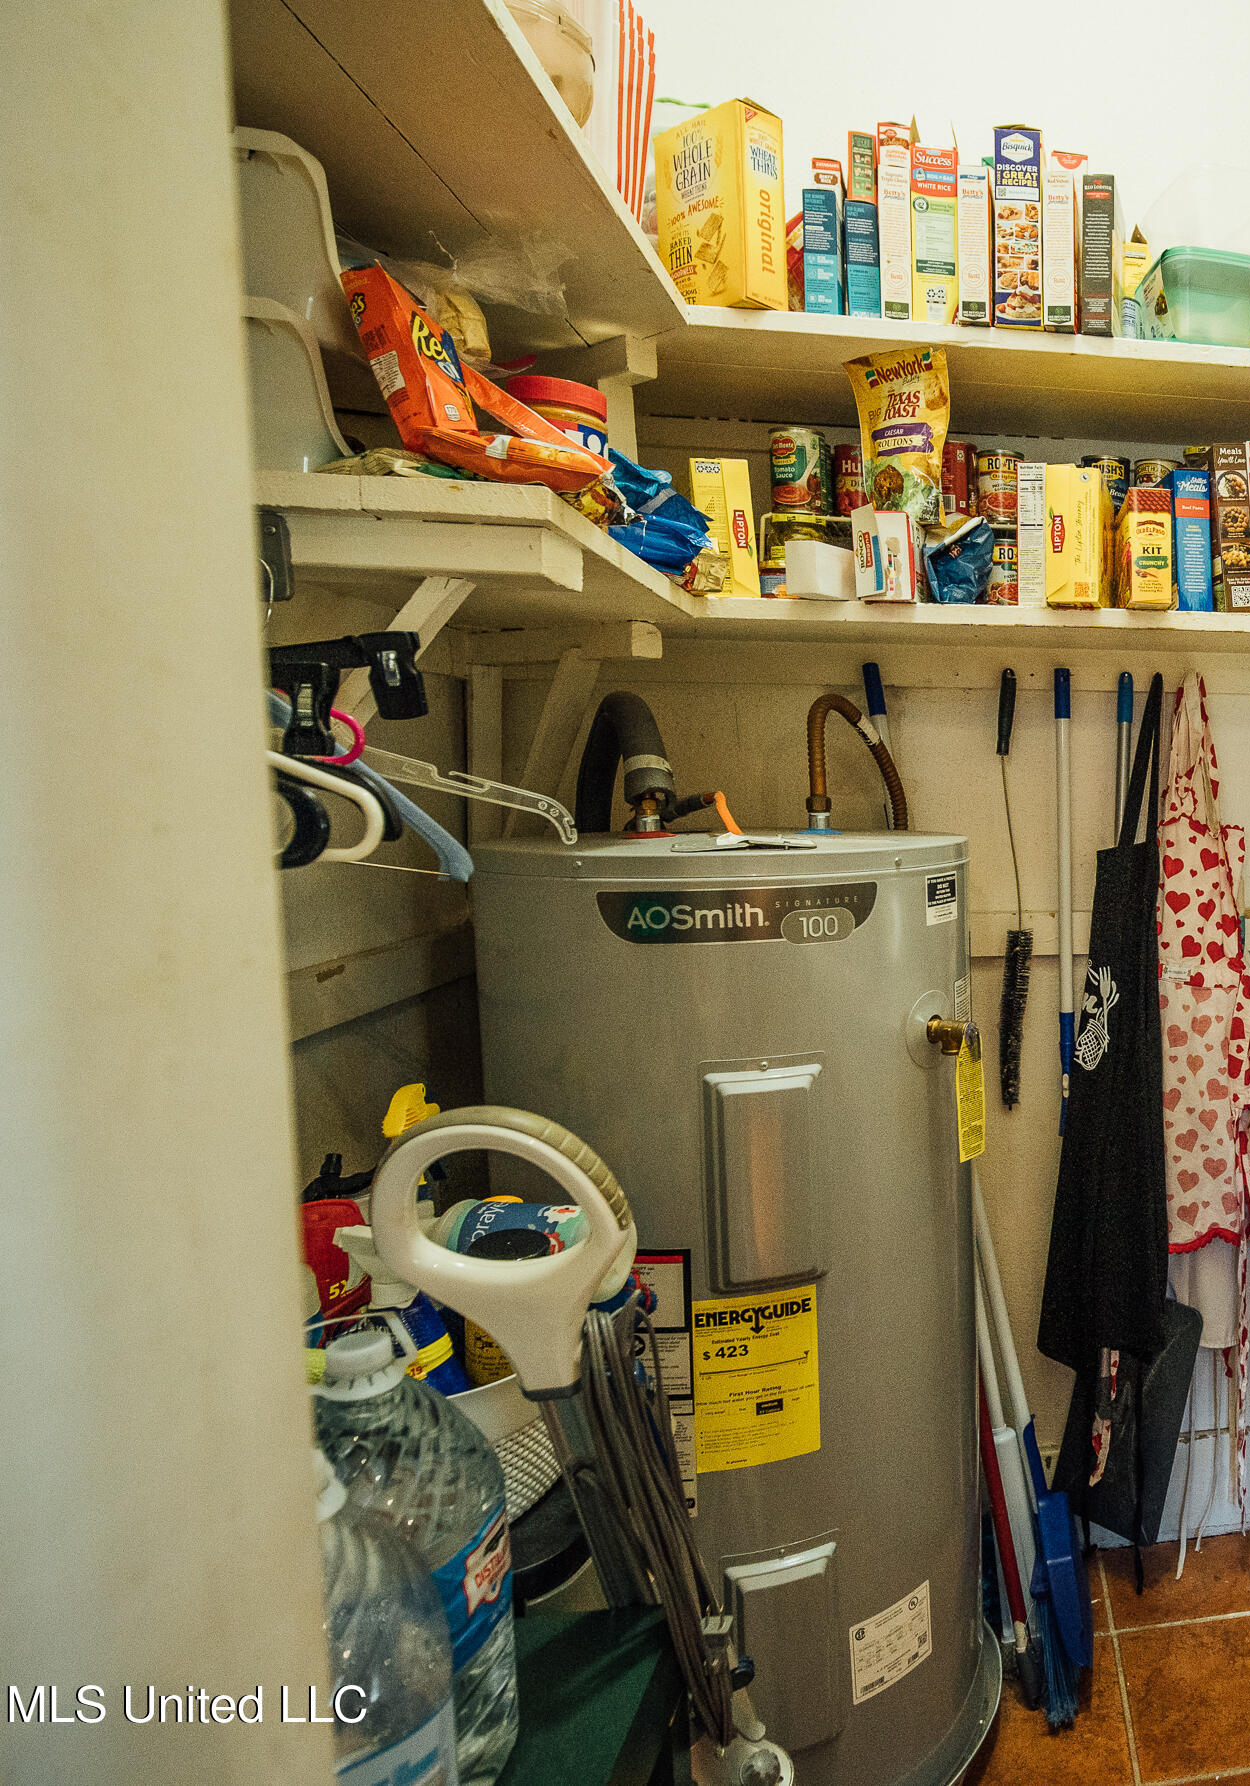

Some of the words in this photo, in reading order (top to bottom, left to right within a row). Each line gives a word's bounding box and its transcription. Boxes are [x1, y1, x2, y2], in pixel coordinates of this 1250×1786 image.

[1002, 142, 1032, 152] Bisquick
[673, 138, 713, 172] WHOLE
[750, 145, 777, 165] WHEAT
[915, 151, 952, 166] Success
[675, 160, 711, 192] GRAIN
[997, 164, 1038, 173] DISCOVER
[1003, 171, 1038, 180] GREAT
[917, 182, 938, 191] WHITE
[939, 184, 952, 192] RICE
[1002, 179, 1037, 187] RECIPES
[688, 196, 718, 216] AWESOME
[757, 189, 776, 275] original
[669, 246, 693, 271] THIN
[887, 391, 921, 408] TEXAS
[883, 405, 920, 421] TOAST
[884, 429, 904, 437] CAESAR
[877, 438, 913, 449] ROUTONS
[1220, 447, 1243, 456] Meals
[1177, 481, 1208, 492] Meals
[735, 511, 747, 548] LIPTON
[1053, 517, 1061, 551] LIPTON
[1142, 546, 1162, 555] KIT
[774, 895, 859, 908] SIGNATURE
[799, 916, 838, 938] 100
[695, 1297, 812, 1331] ENERGYGUIDE
[712, 1336, 734, 1345] Estimated
[752, 1332, 768, 1340] Energy
[715, 1344, 749, 1359] 423
[762, 1385, 781, 1394] Rating
